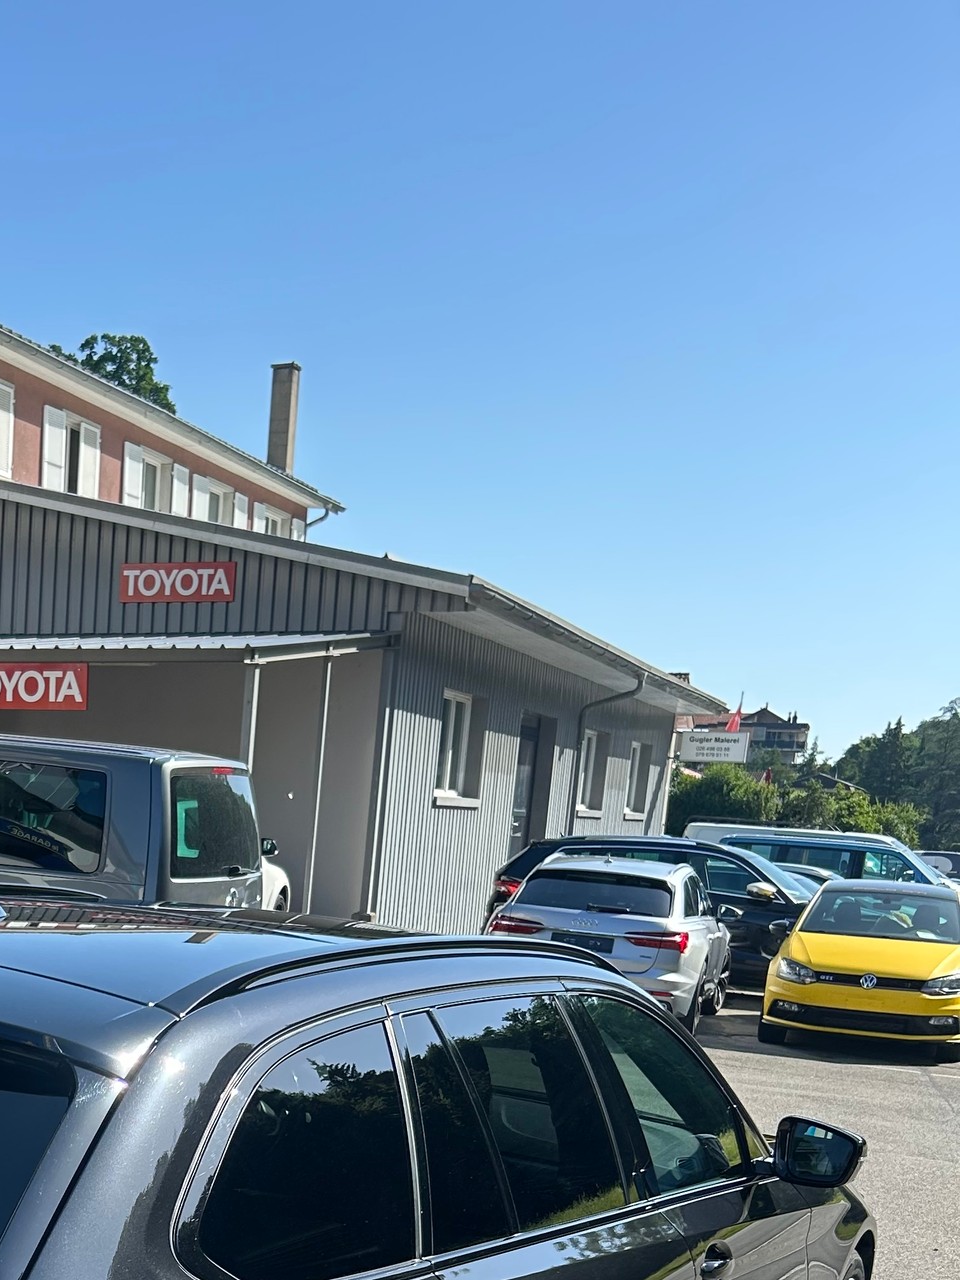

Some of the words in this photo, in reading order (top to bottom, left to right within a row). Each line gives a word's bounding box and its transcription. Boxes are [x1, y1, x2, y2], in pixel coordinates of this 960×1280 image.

[123, 568, 230, 596] TOYOTA
[689, 736, 713, 744] Gugler
[714, 736, 740, 744] Malerei
